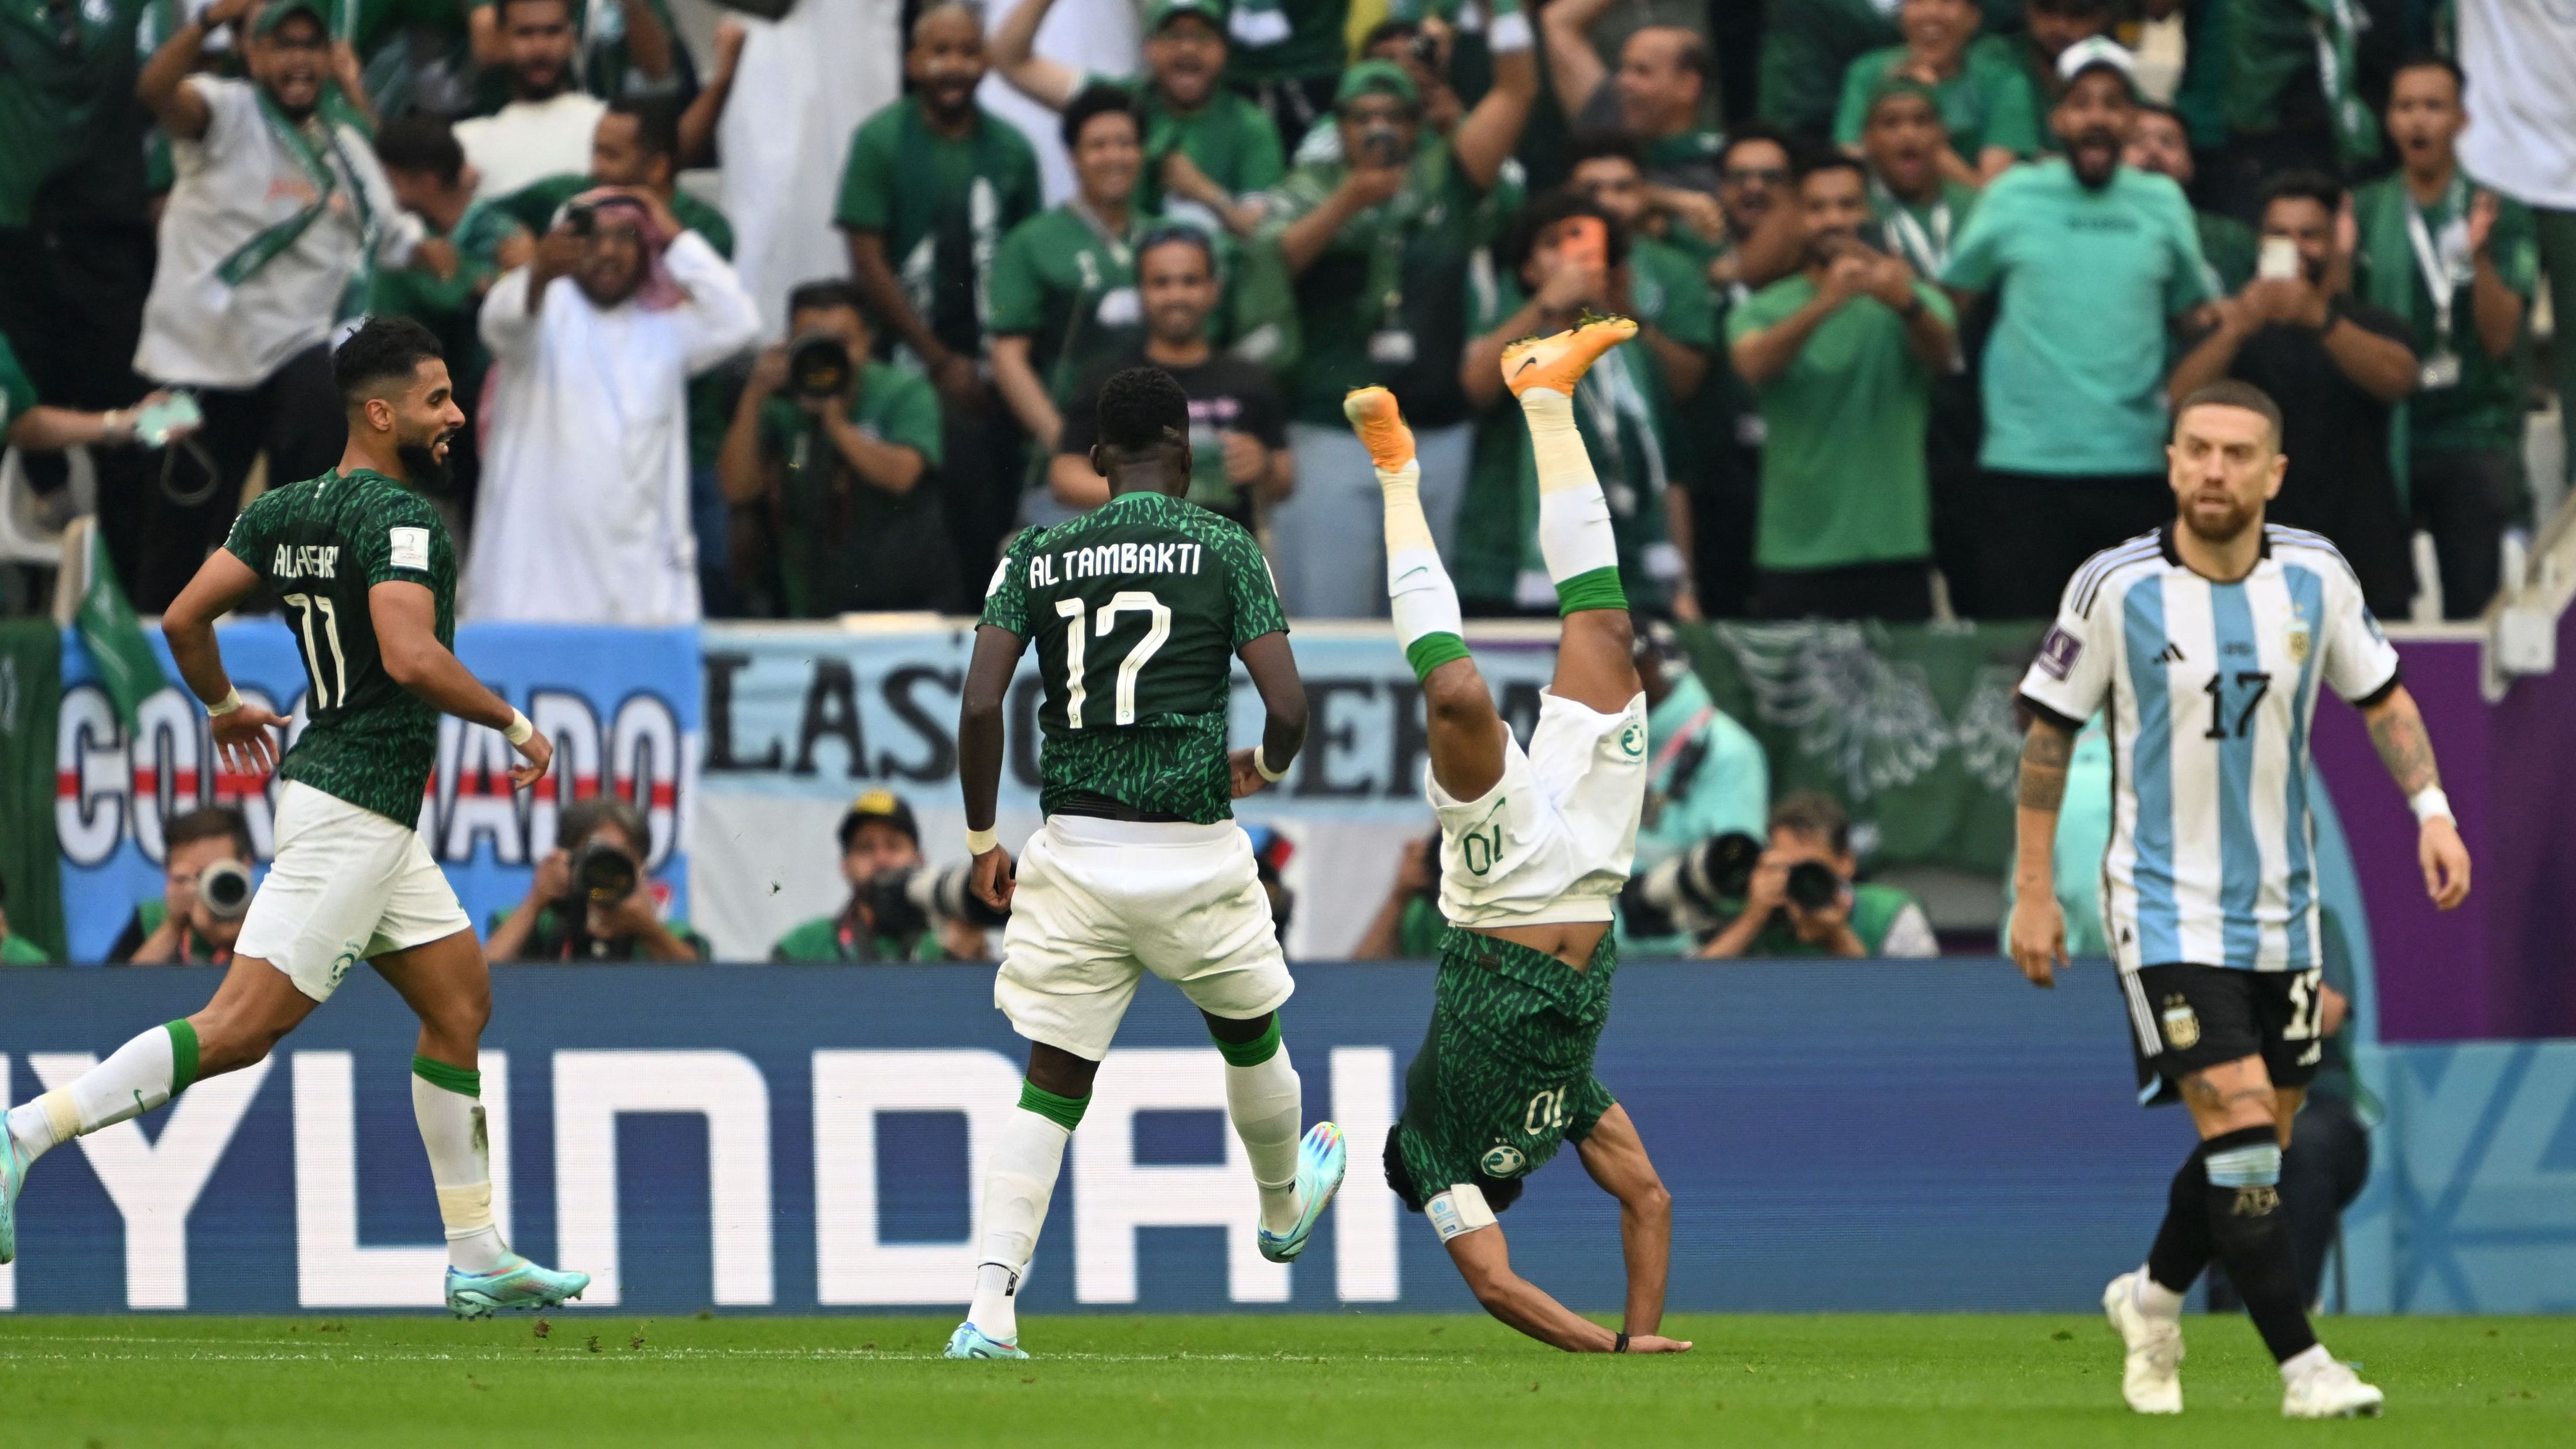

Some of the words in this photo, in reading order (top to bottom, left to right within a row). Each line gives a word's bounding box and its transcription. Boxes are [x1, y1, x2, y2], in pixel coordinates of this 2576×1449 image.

[1029, 555, 1060, 590] AL
[1063, 542, 1201, 580] TAMBAKTI
[282, 592, 346, 709] 11
[1054, 590, 1171, 729] 17
[2202, 671, 2271, 739] 17
[54, 684, 679, 872] CORADO
[704, 651, 963, 783] LAS
[0, 1047, 1400, 1311] YUNDAI
